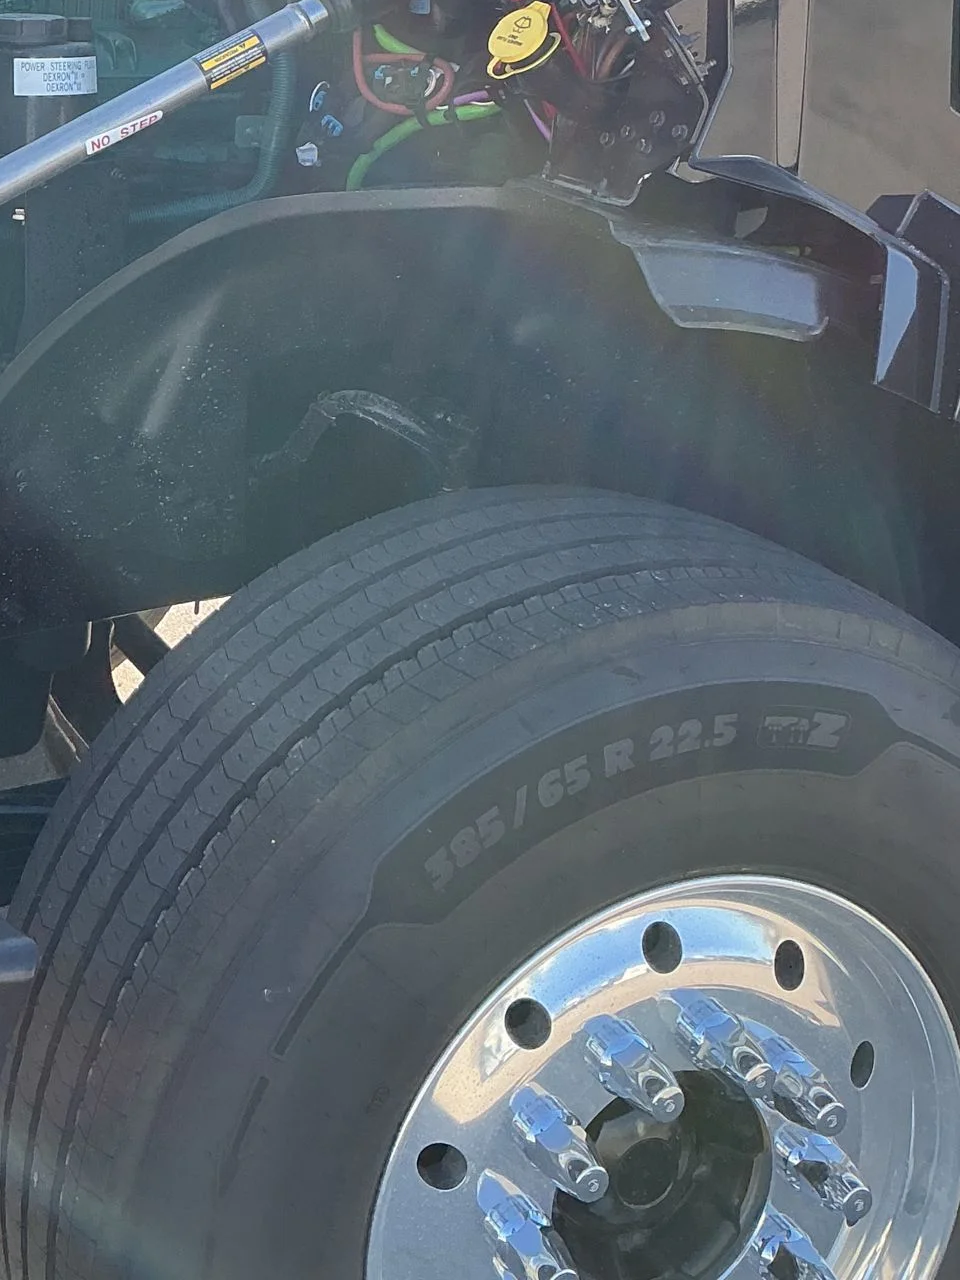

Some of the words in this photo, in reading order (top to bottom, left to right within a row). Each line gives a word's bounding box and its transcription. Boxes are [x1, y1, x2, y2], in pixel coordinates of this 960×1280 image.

[20, 61, 45, 72] POWER
[50, 60, 82, 71] STEERING
[90, 134, 111, 152] NO
[603, 737, 636, 778] R
[649, 712, 739, 762] 22.5
